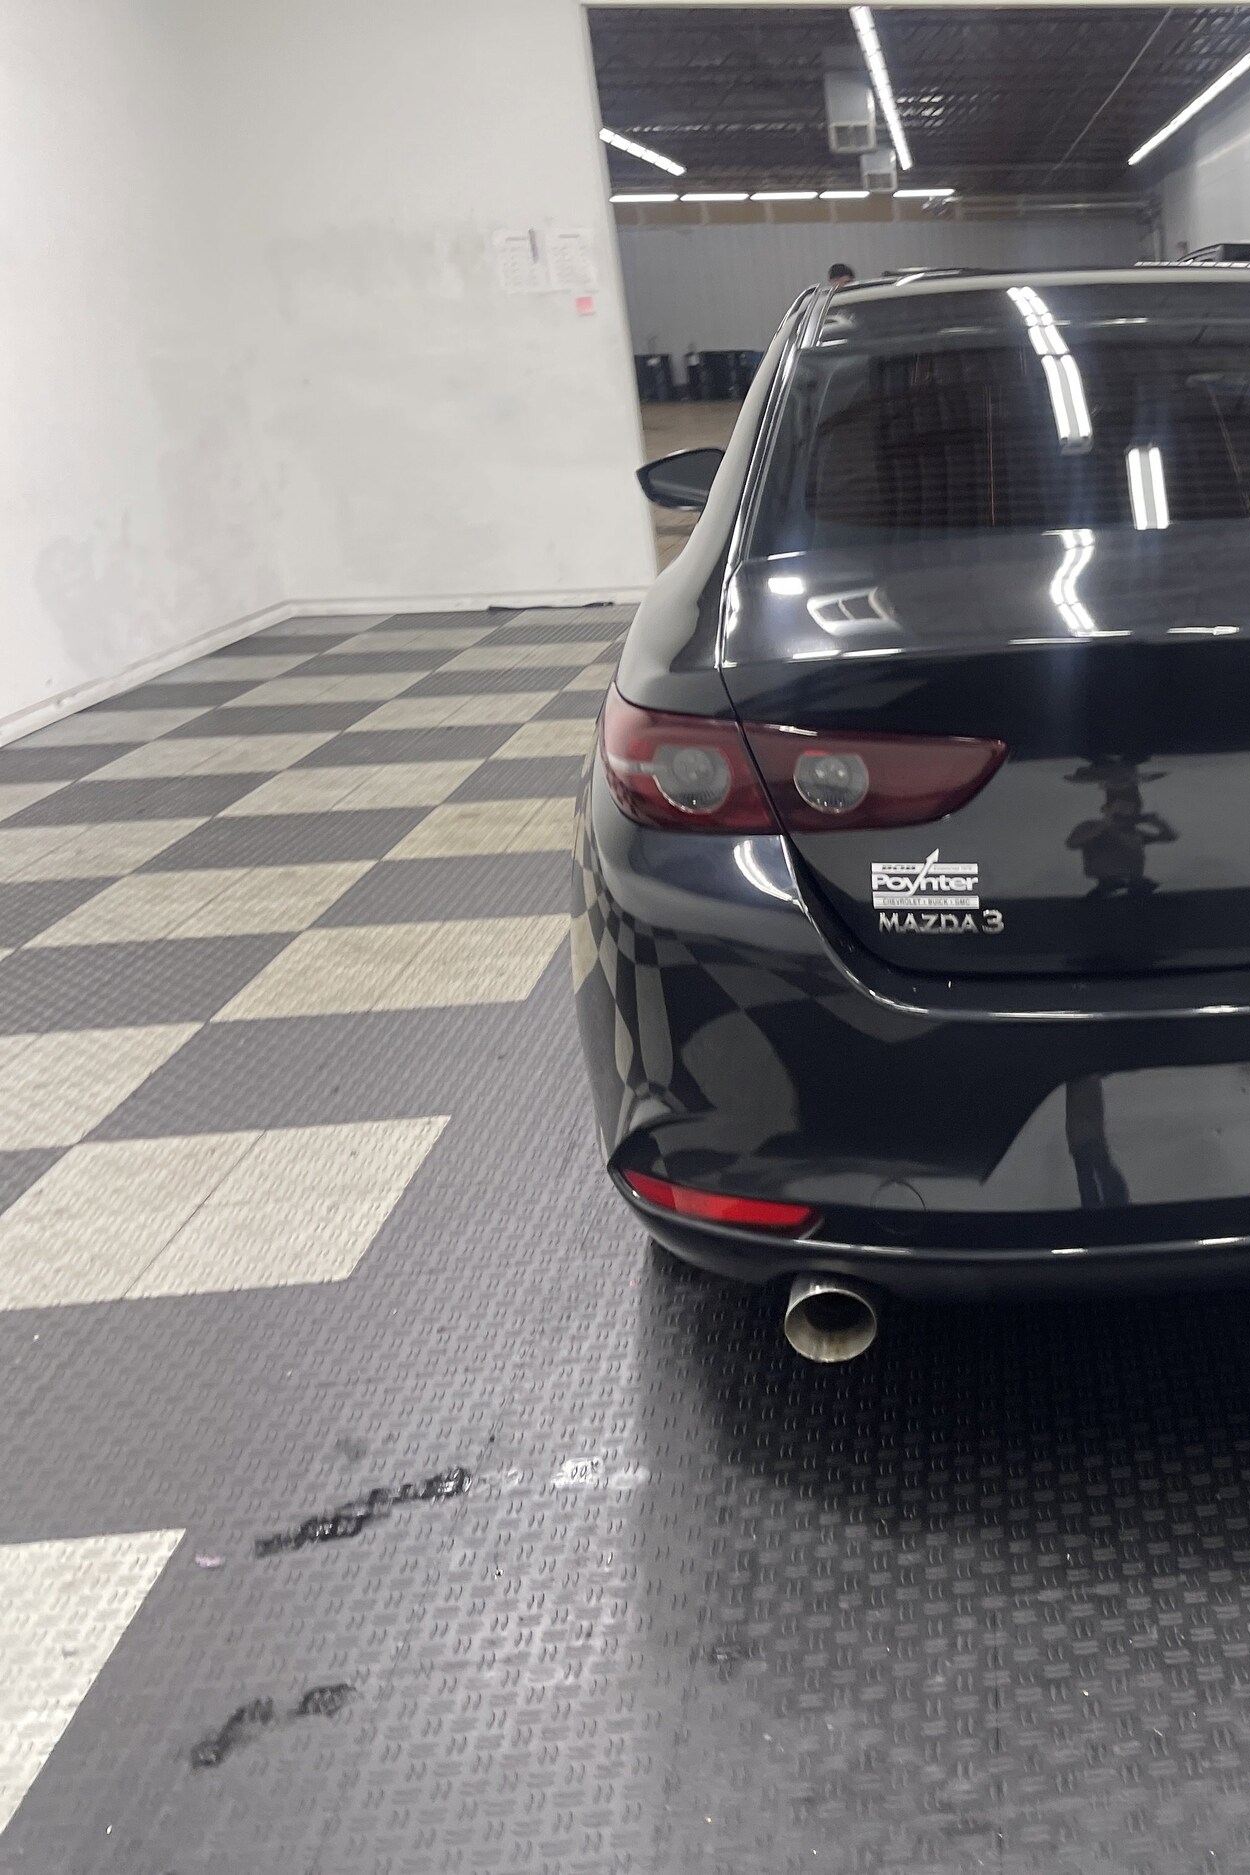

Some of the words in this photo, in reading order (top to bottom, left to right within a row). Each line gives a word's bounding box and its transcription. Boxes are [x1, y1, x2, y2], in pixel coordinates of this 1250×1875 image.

[872, 872, 979, 894] Poynter
[882, 897, 921, 907] CHEVROLET
[928, 897, 949, 907] BUICK
[954, 897, 971, 907] GMC
